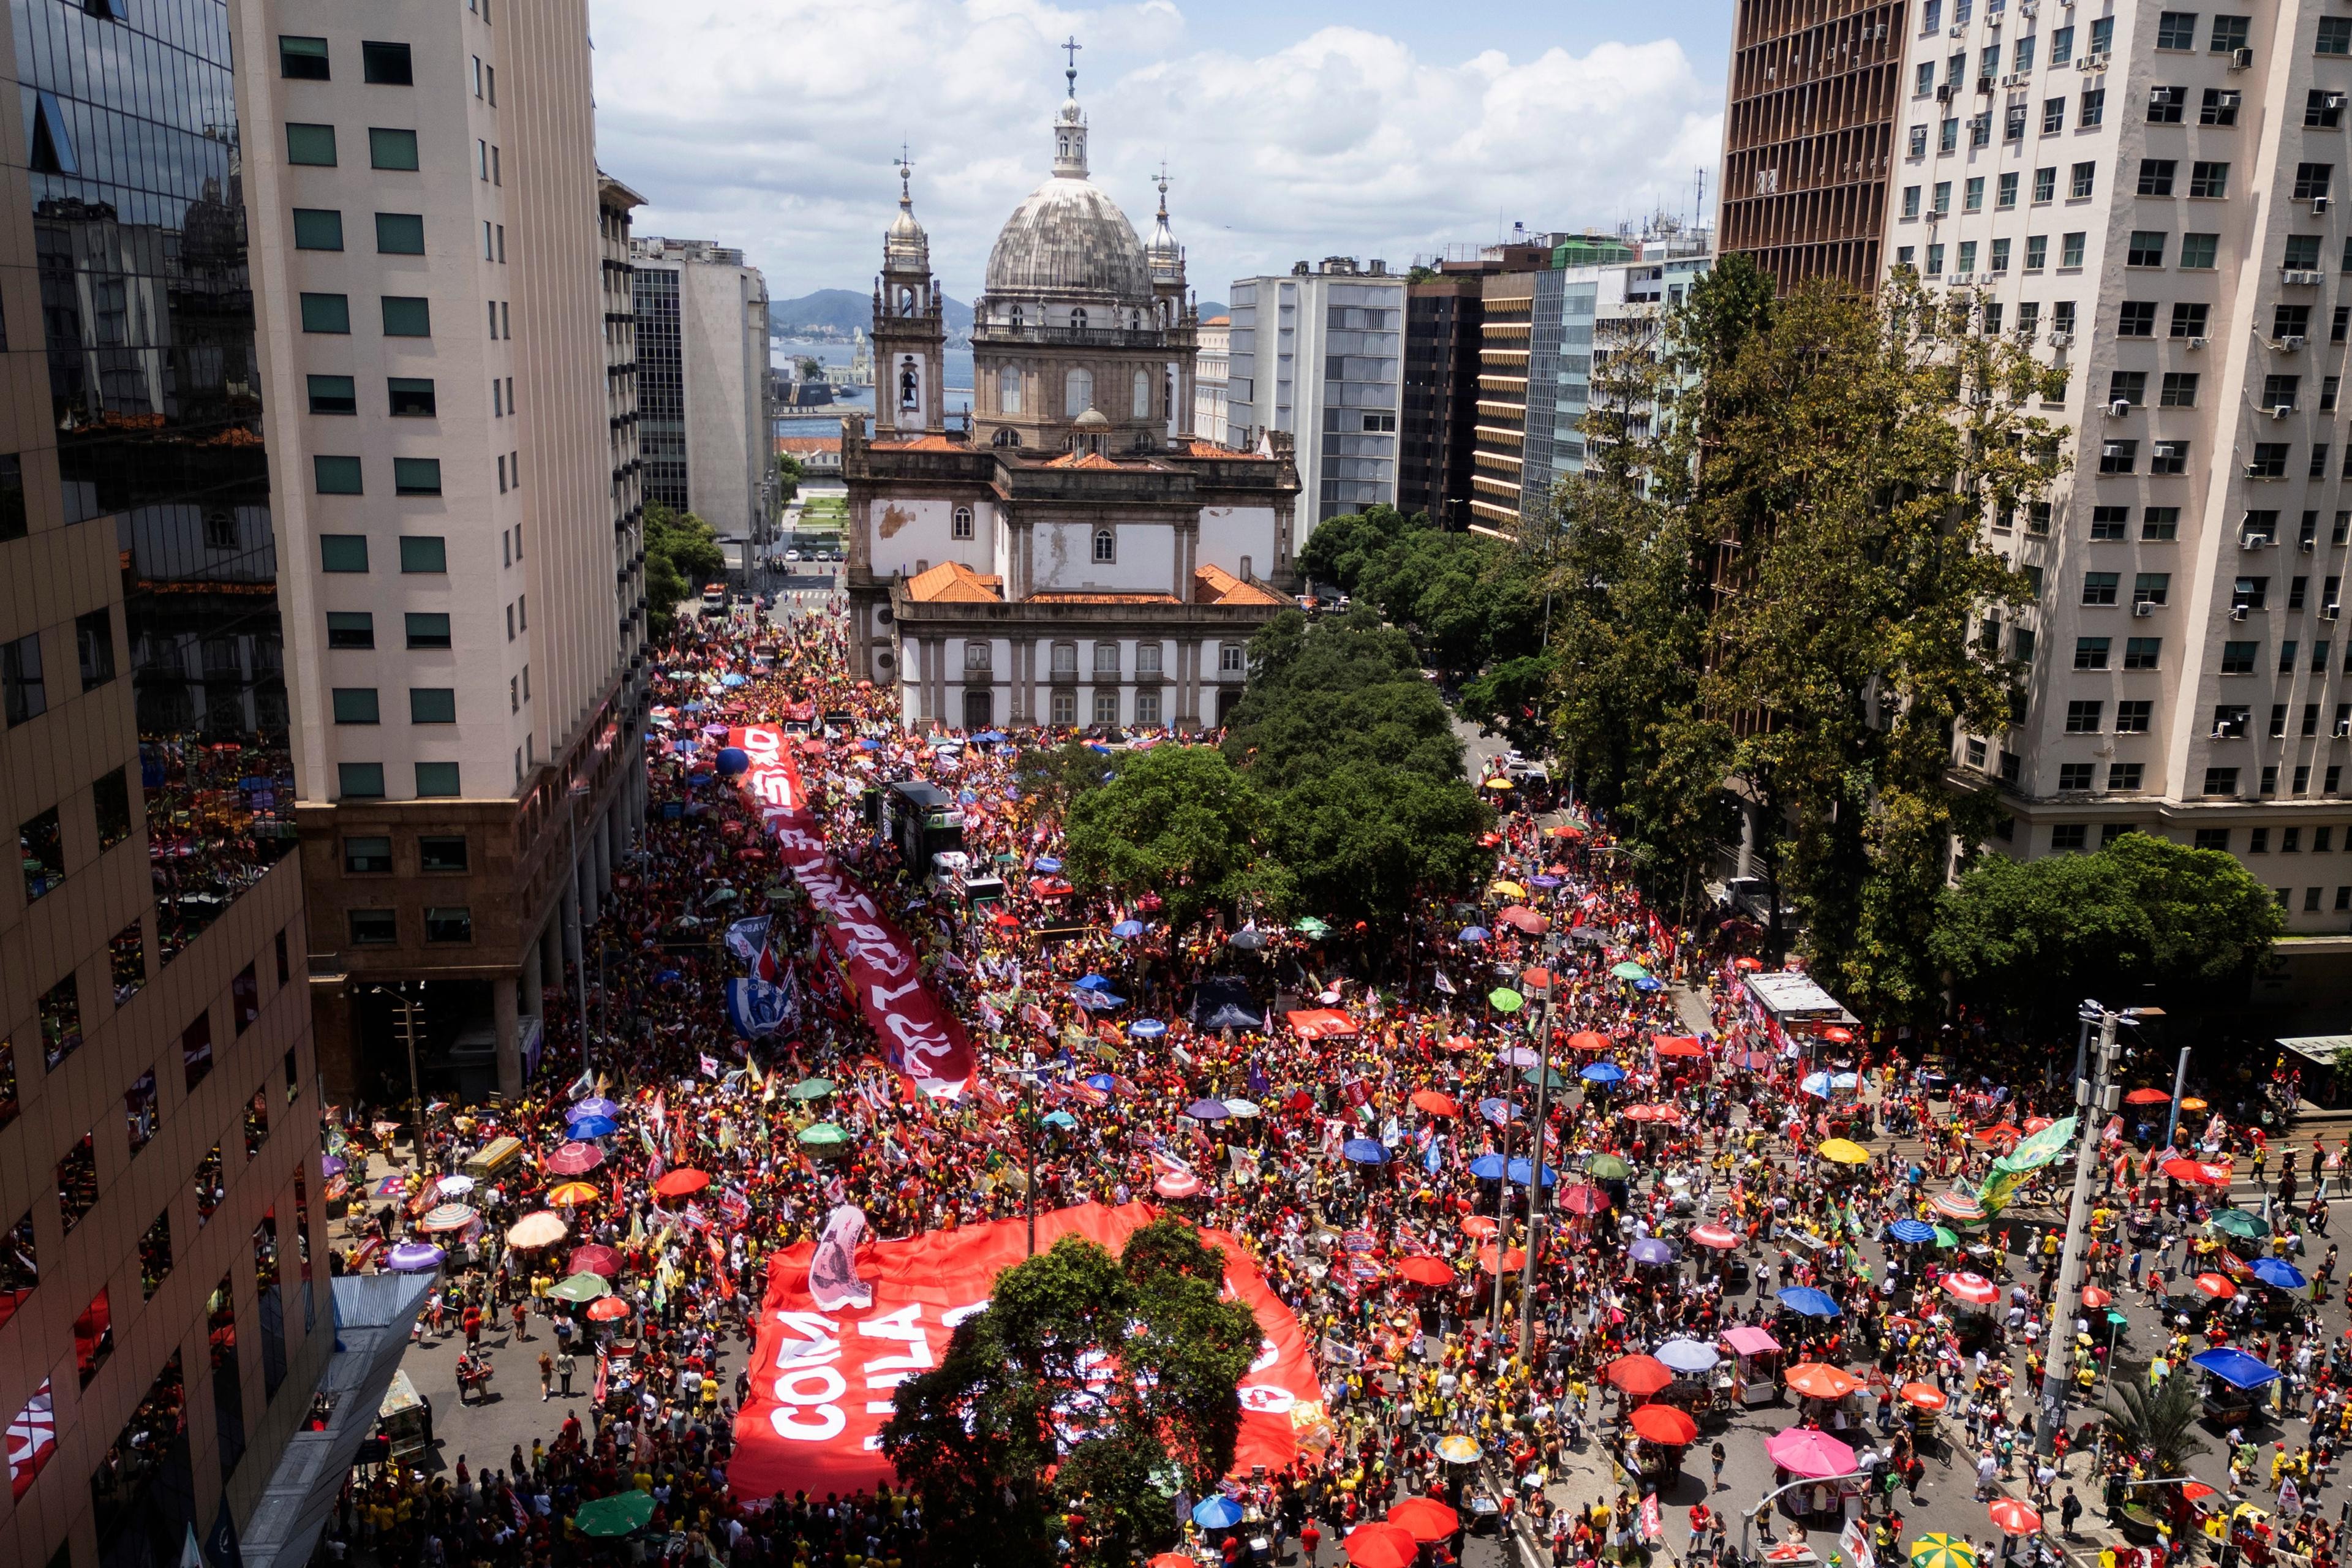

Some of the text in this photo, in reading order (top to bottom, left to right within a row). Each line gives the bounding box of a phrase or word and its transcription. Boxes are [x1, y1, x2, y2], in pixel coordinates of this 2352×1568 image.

[870, 978, 969, 1099] LULA
[769, 1311, 847, 1441] COM
[858, 1303, 935, 1451] ULA
